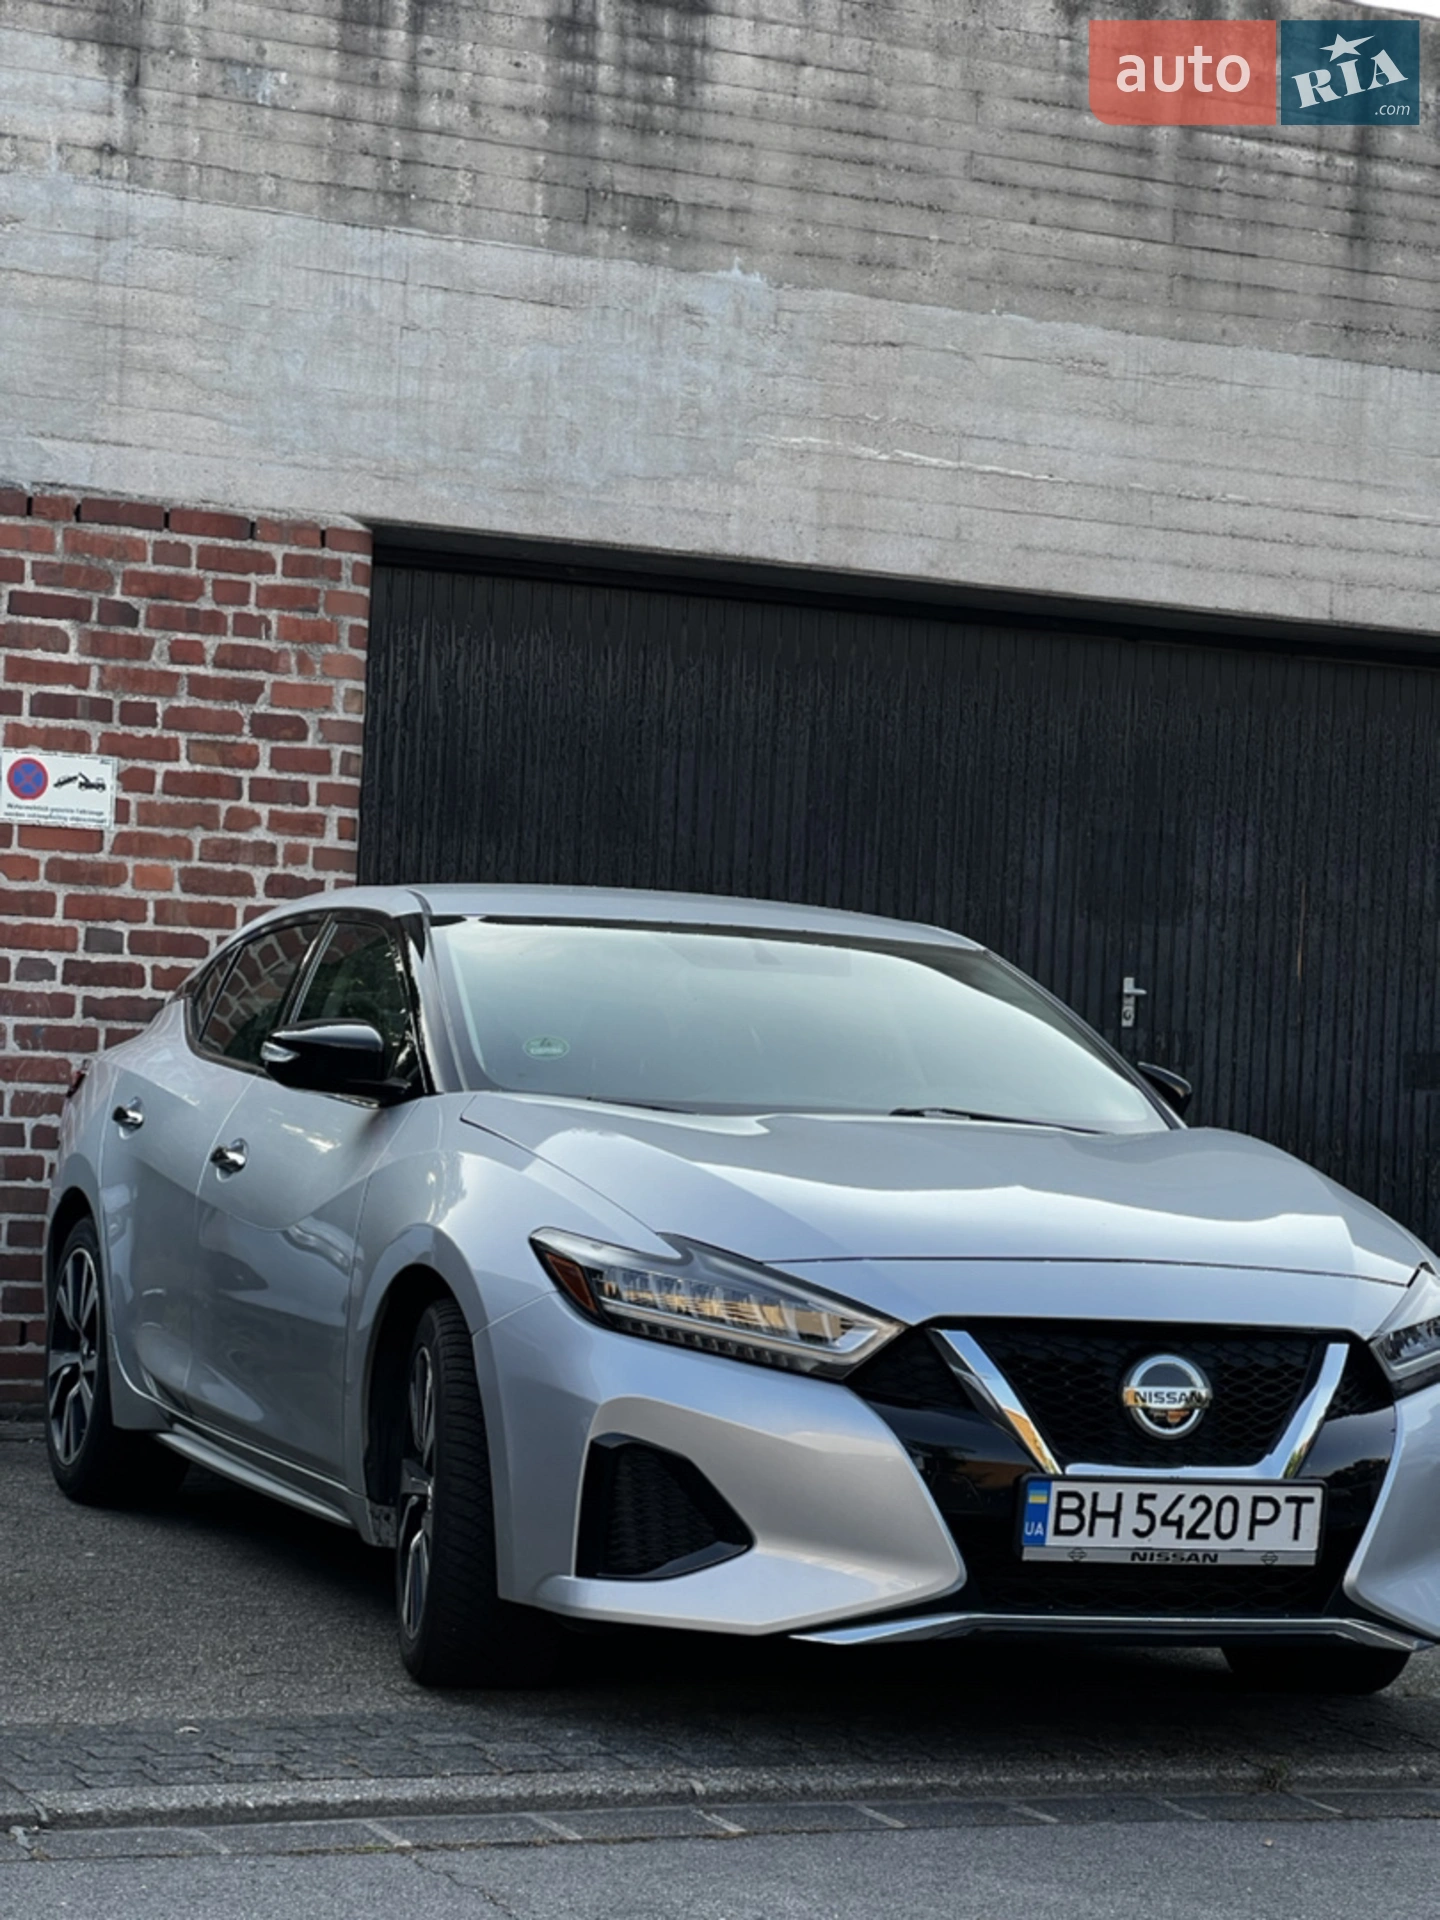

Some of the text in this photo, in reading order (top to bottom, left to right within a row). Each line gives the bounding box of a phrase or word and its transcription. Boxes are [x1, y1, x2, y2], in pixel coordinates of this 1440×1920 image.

[1133, 1390, 1206, 1405] NISSAN
[1053, 1490, 1315, 1541] BH 5420 PT
[1024, 1521, 1045, 1537] UA
[1130, 1551, 1219, 1564] NISSAN
